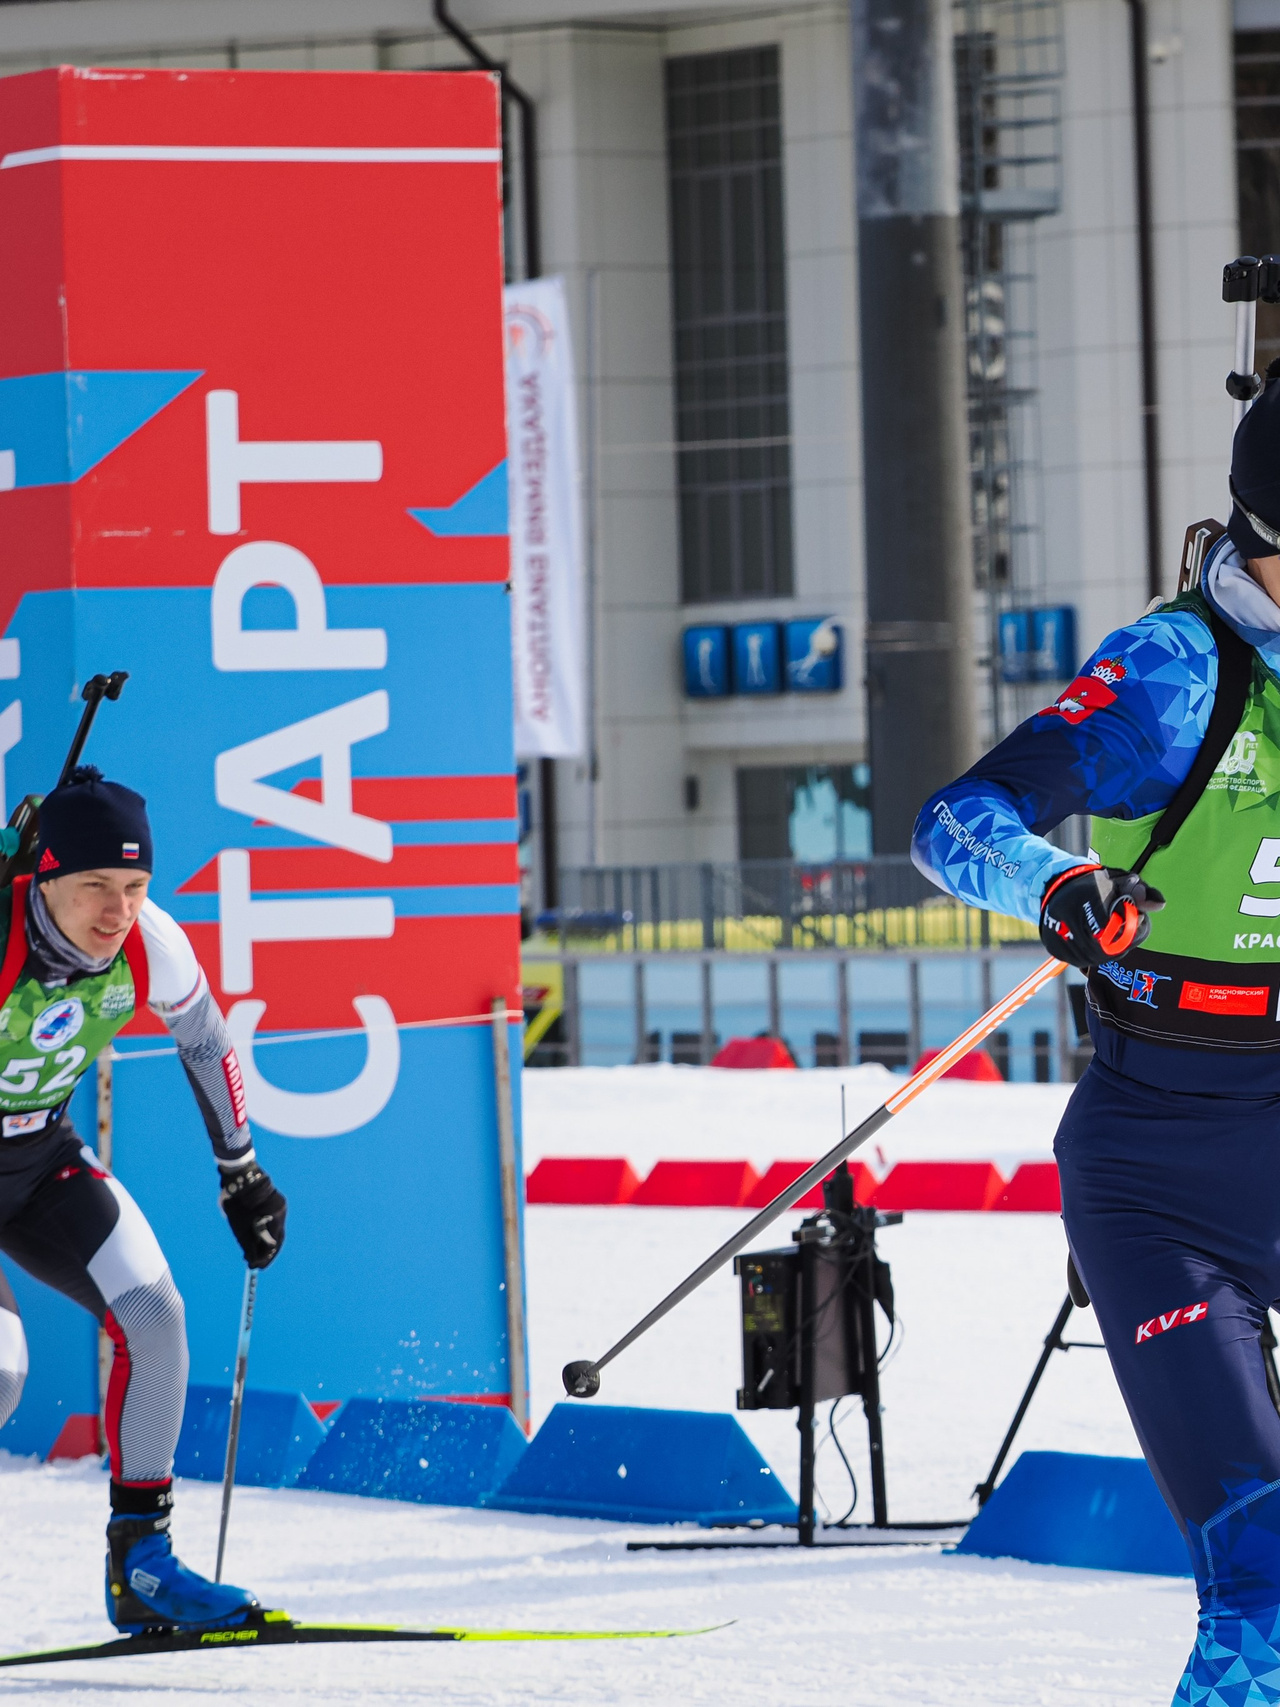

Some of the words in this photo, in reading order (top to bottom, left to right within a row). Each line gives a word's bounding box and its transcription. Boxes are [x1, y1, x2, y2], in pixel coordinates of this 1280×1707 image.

[206, 389, 400, 1138] СТАРТ
[933, 800, 990, 857] ПЕРМСКИЙ
[985, 846, 1021, 879] КРАЙ
[1210, 988, 1264, 996] КРАСНОЯРСКИЙ
[0, 1045, 87, 1095] 52
[1136, 1303, 1208, 1344] KV+
[201, 1629, 258, 1643] FISCHER
